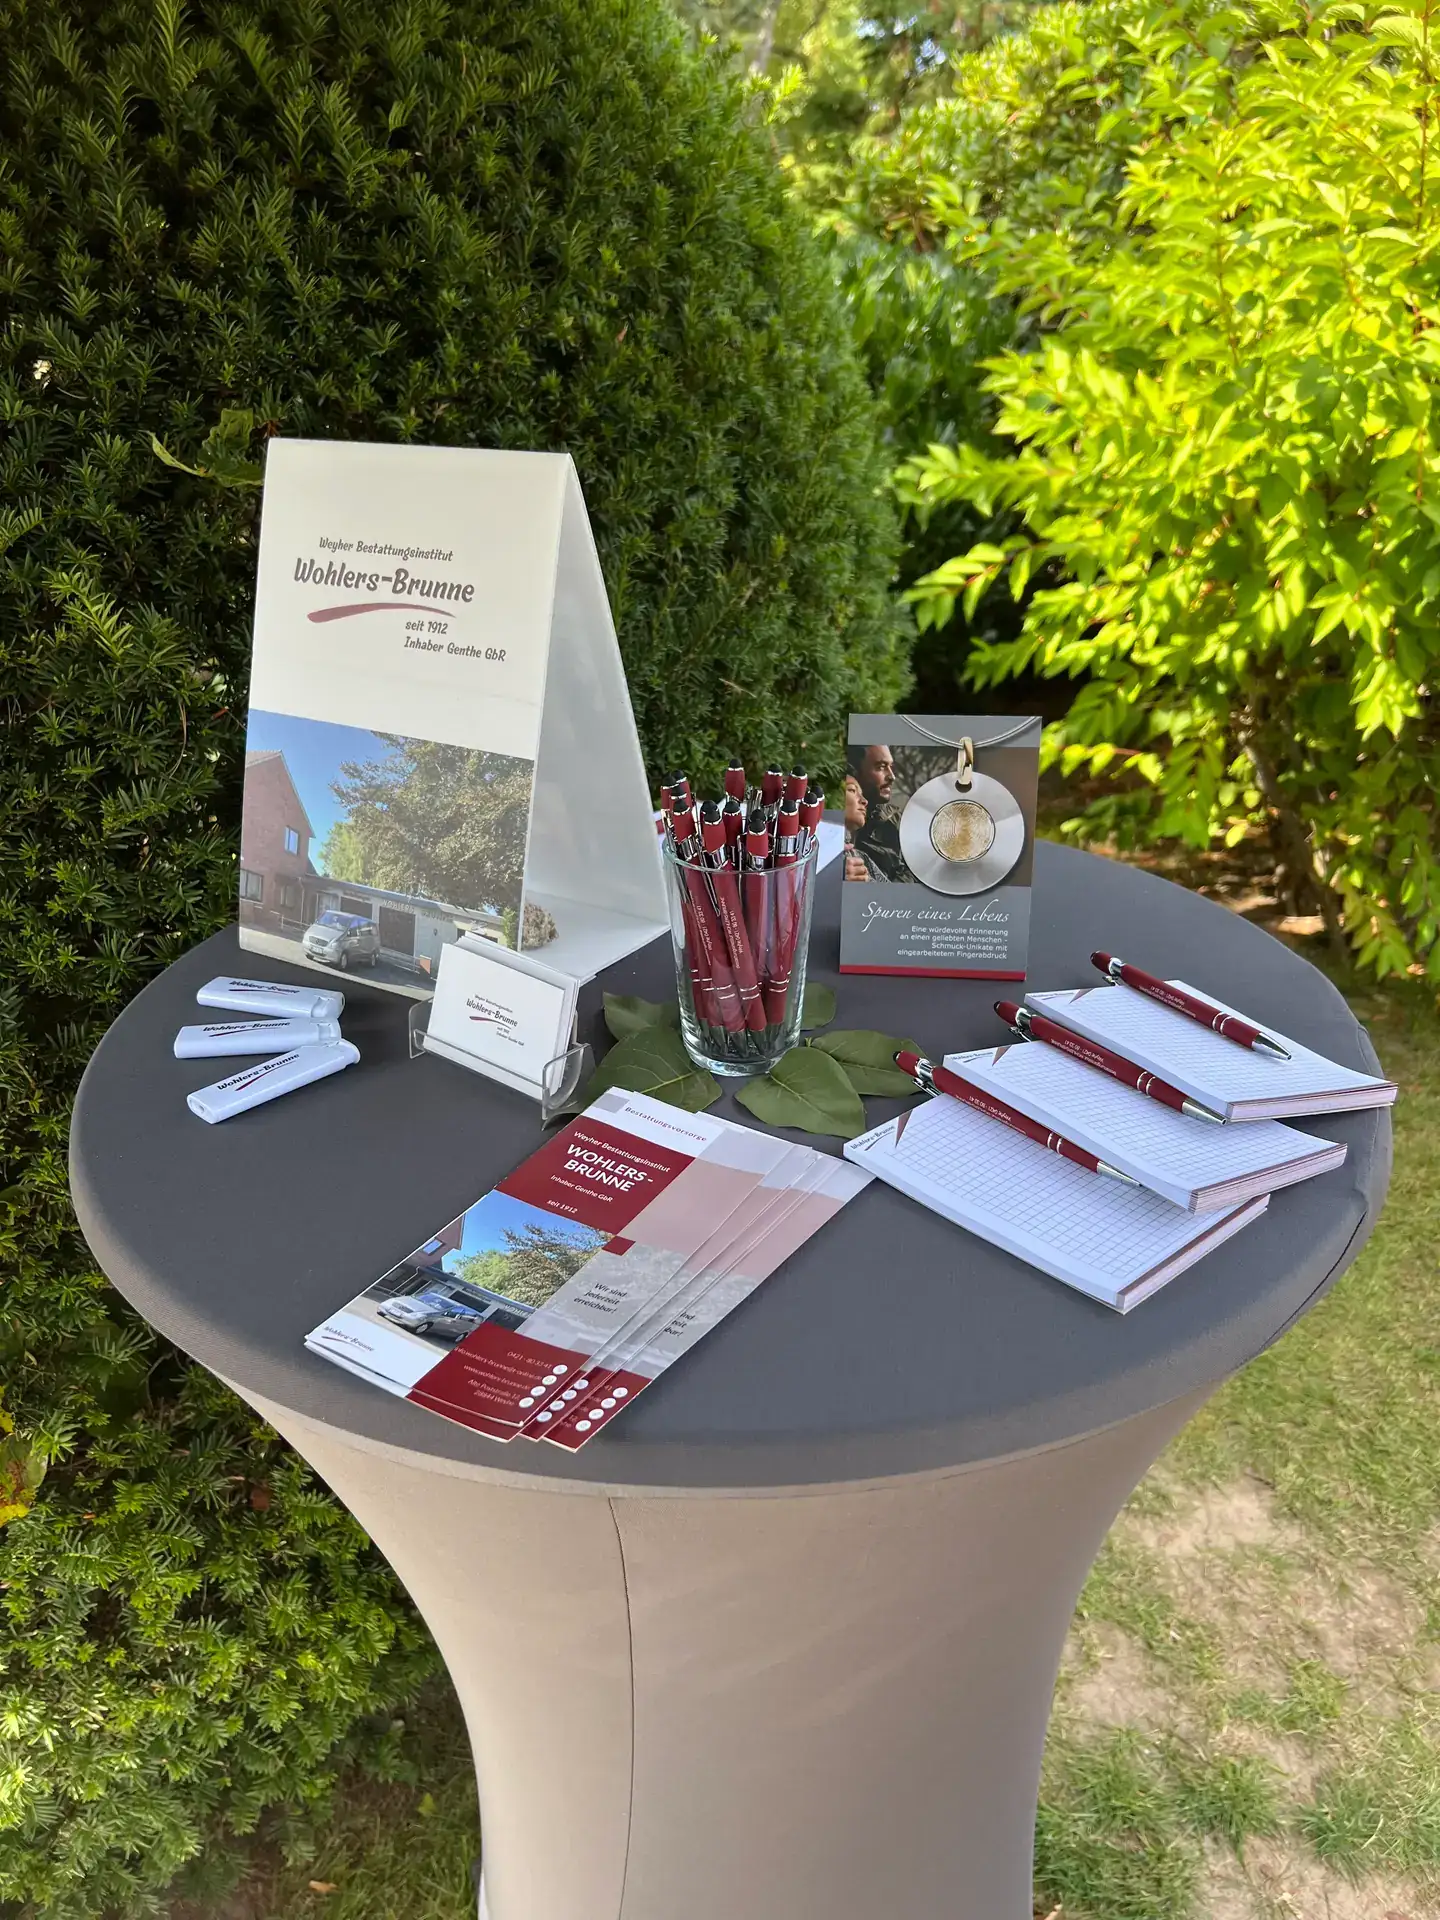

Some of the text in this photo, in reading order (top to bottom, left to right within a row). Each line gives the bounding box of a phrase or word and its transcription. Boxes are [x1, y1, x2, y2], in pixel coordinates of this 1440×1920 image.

[319, 537, 453, 561] Weyher Bestattungsinstitut
[294, 558, 474, 602] Wohlers-Brunne
[405, 621, 448, 634] seit 1912
[404, 636, 506, 662] Inhaber Genthe GbR
[862, 899, 1010, 932] Spuren eines Lebens
[969, 928, 1008, 936] Erinnerung
[957, 951, 1007, 959] Fingerabdruck
[466, 998, 518, 1027] Wohlers-Brunne
[203, 1021, 290, 1032] Wohlers-Brunne
[217, 1054, 300, 1090] Wohlers-Brunne
[625, 1106, 707, 1142] Bestattungsvorsorge
[574, 1131, 671, 1173] Weyher Bestattungsinstitut
[564, 1159, 635, 1192] BRUNNE
[550, 1175, 614, 1203] Inhaber Genthe GbR
[547, 1200, 578, 1214] seit 1912
[584, 1291, 620, 1305] jederzeit
[594, 1283, 628, 1298] Wir sind
[574, 1297, 618, 1314] erreichbar!
[680, 1312, 696, 1320] ind
